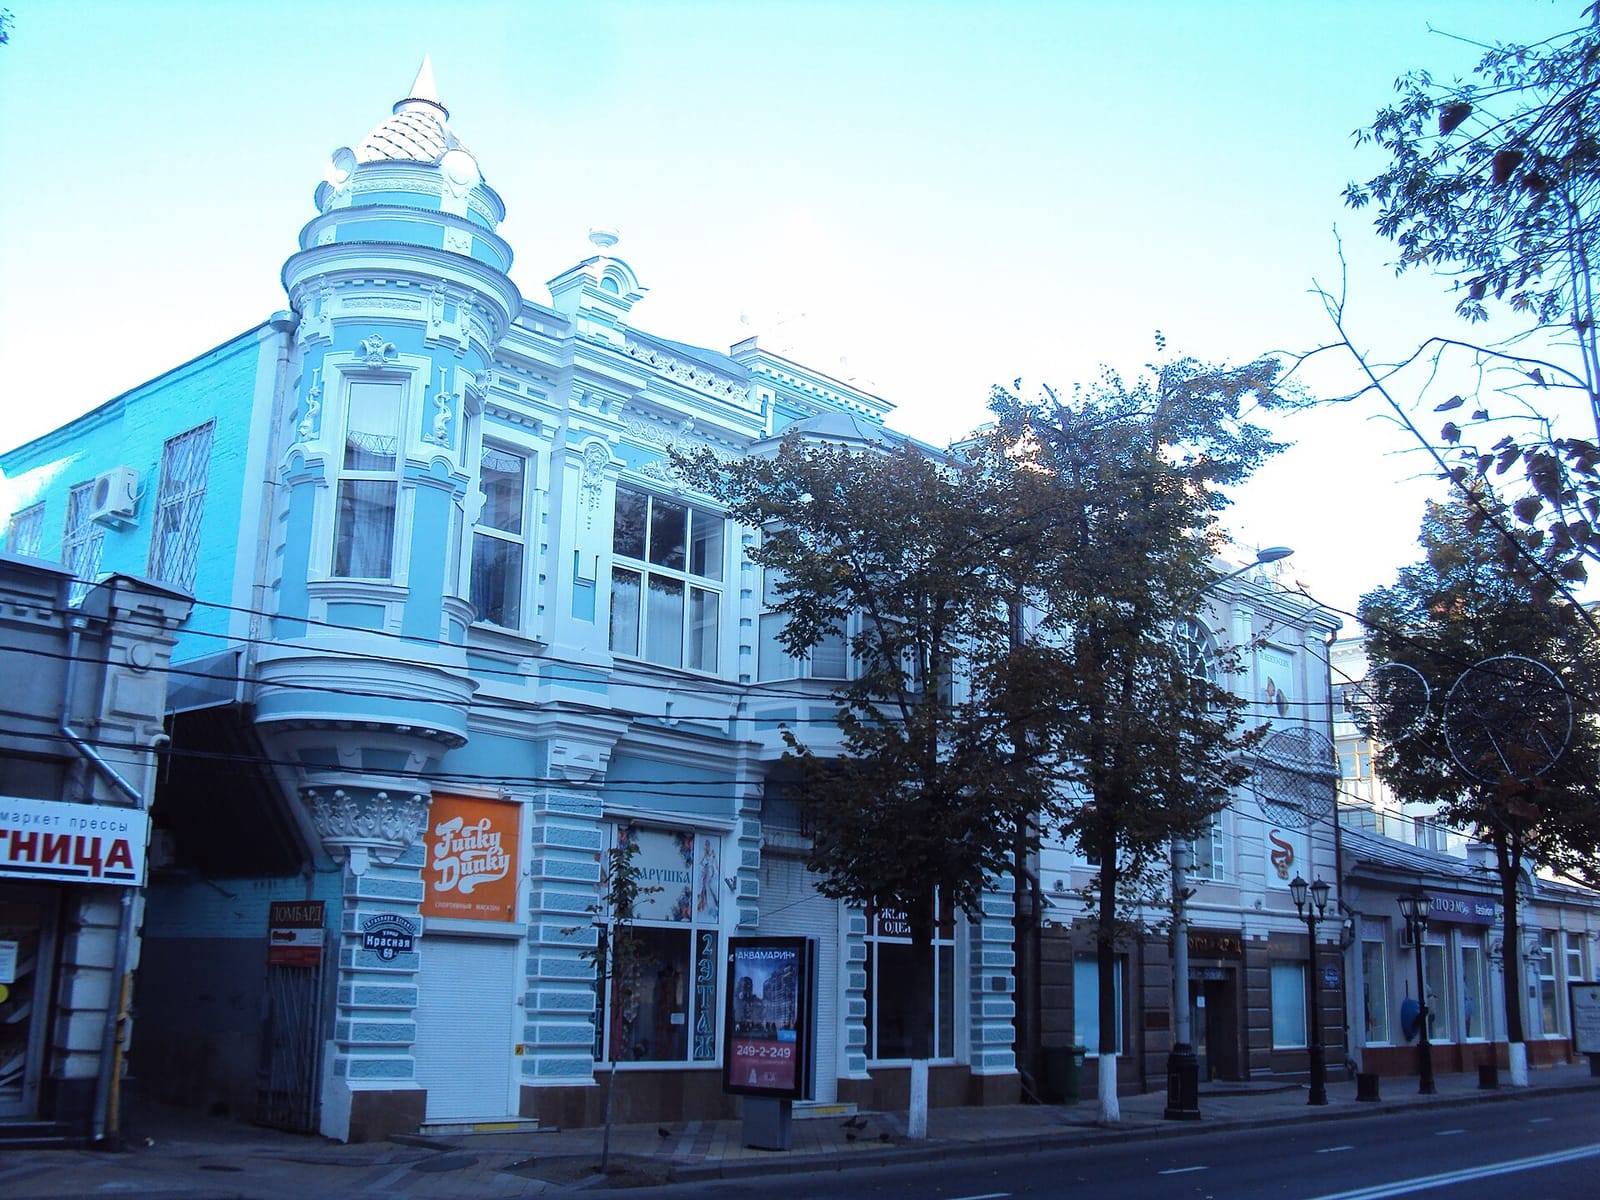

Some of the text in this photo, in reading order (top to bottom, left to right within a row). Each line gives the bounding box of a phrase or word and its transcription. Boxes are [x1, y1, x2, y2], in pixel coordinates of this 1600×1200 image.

[70, 817, 128, 832] прессы
[434, 816, 501, 857] Funky
[433, 847, 510, 893] Dunky
[272, 905, 321, 922] ЛОМБАРД
[366, 935, 410, 948] Красная
[736, 1045, 792, 1059] 249-2-249
